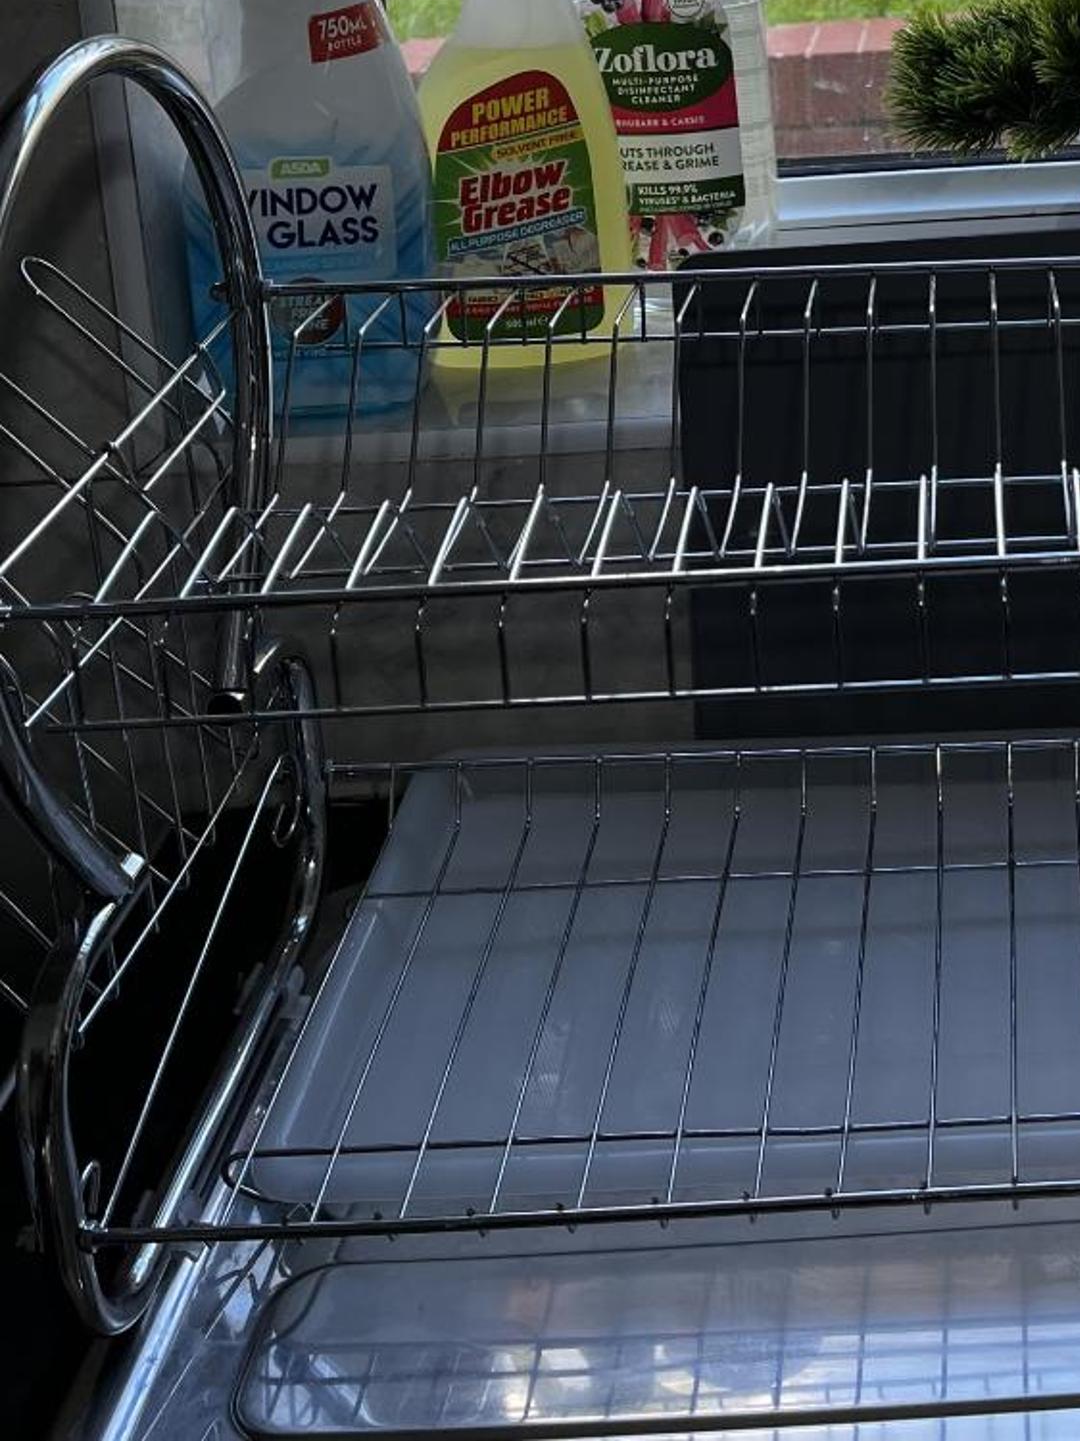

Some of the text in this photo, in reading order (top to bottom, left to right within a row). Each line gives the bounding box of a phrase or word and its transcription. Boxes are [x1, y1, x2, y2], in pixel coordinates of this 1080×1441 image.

[594, 44, 719, 74] Zoflora
[612, 74, 699, 87] MULTI-PURPOSE
[617, 84, 696, 97] DISINFECTANT
[631, 94, 682, 105] CLEANER
[471, 87, 549, 126] POWER
[450, 106, 569, 149] PERFORMANCE
[496, 139, 548, 158] SOLVENT
[620, 142, 715, 159] UTS THROUGH
[280, 161, 322, 175] ASDA
[662, 160, 673, 171] &
[675, 155, 720, 171] GRIME
[460, 160, 568, 207] Elbow
[637, 184, 699, 196] KILLS 99.9%
[690, 190, 737, 203] BACTERIA
[462, 187, 572, 235] Grease
[266, 215, 379, 250] GLASS
[467, 229, 520, 249] PURPOSE
[519, 210, 585, 237] DEGREASER
